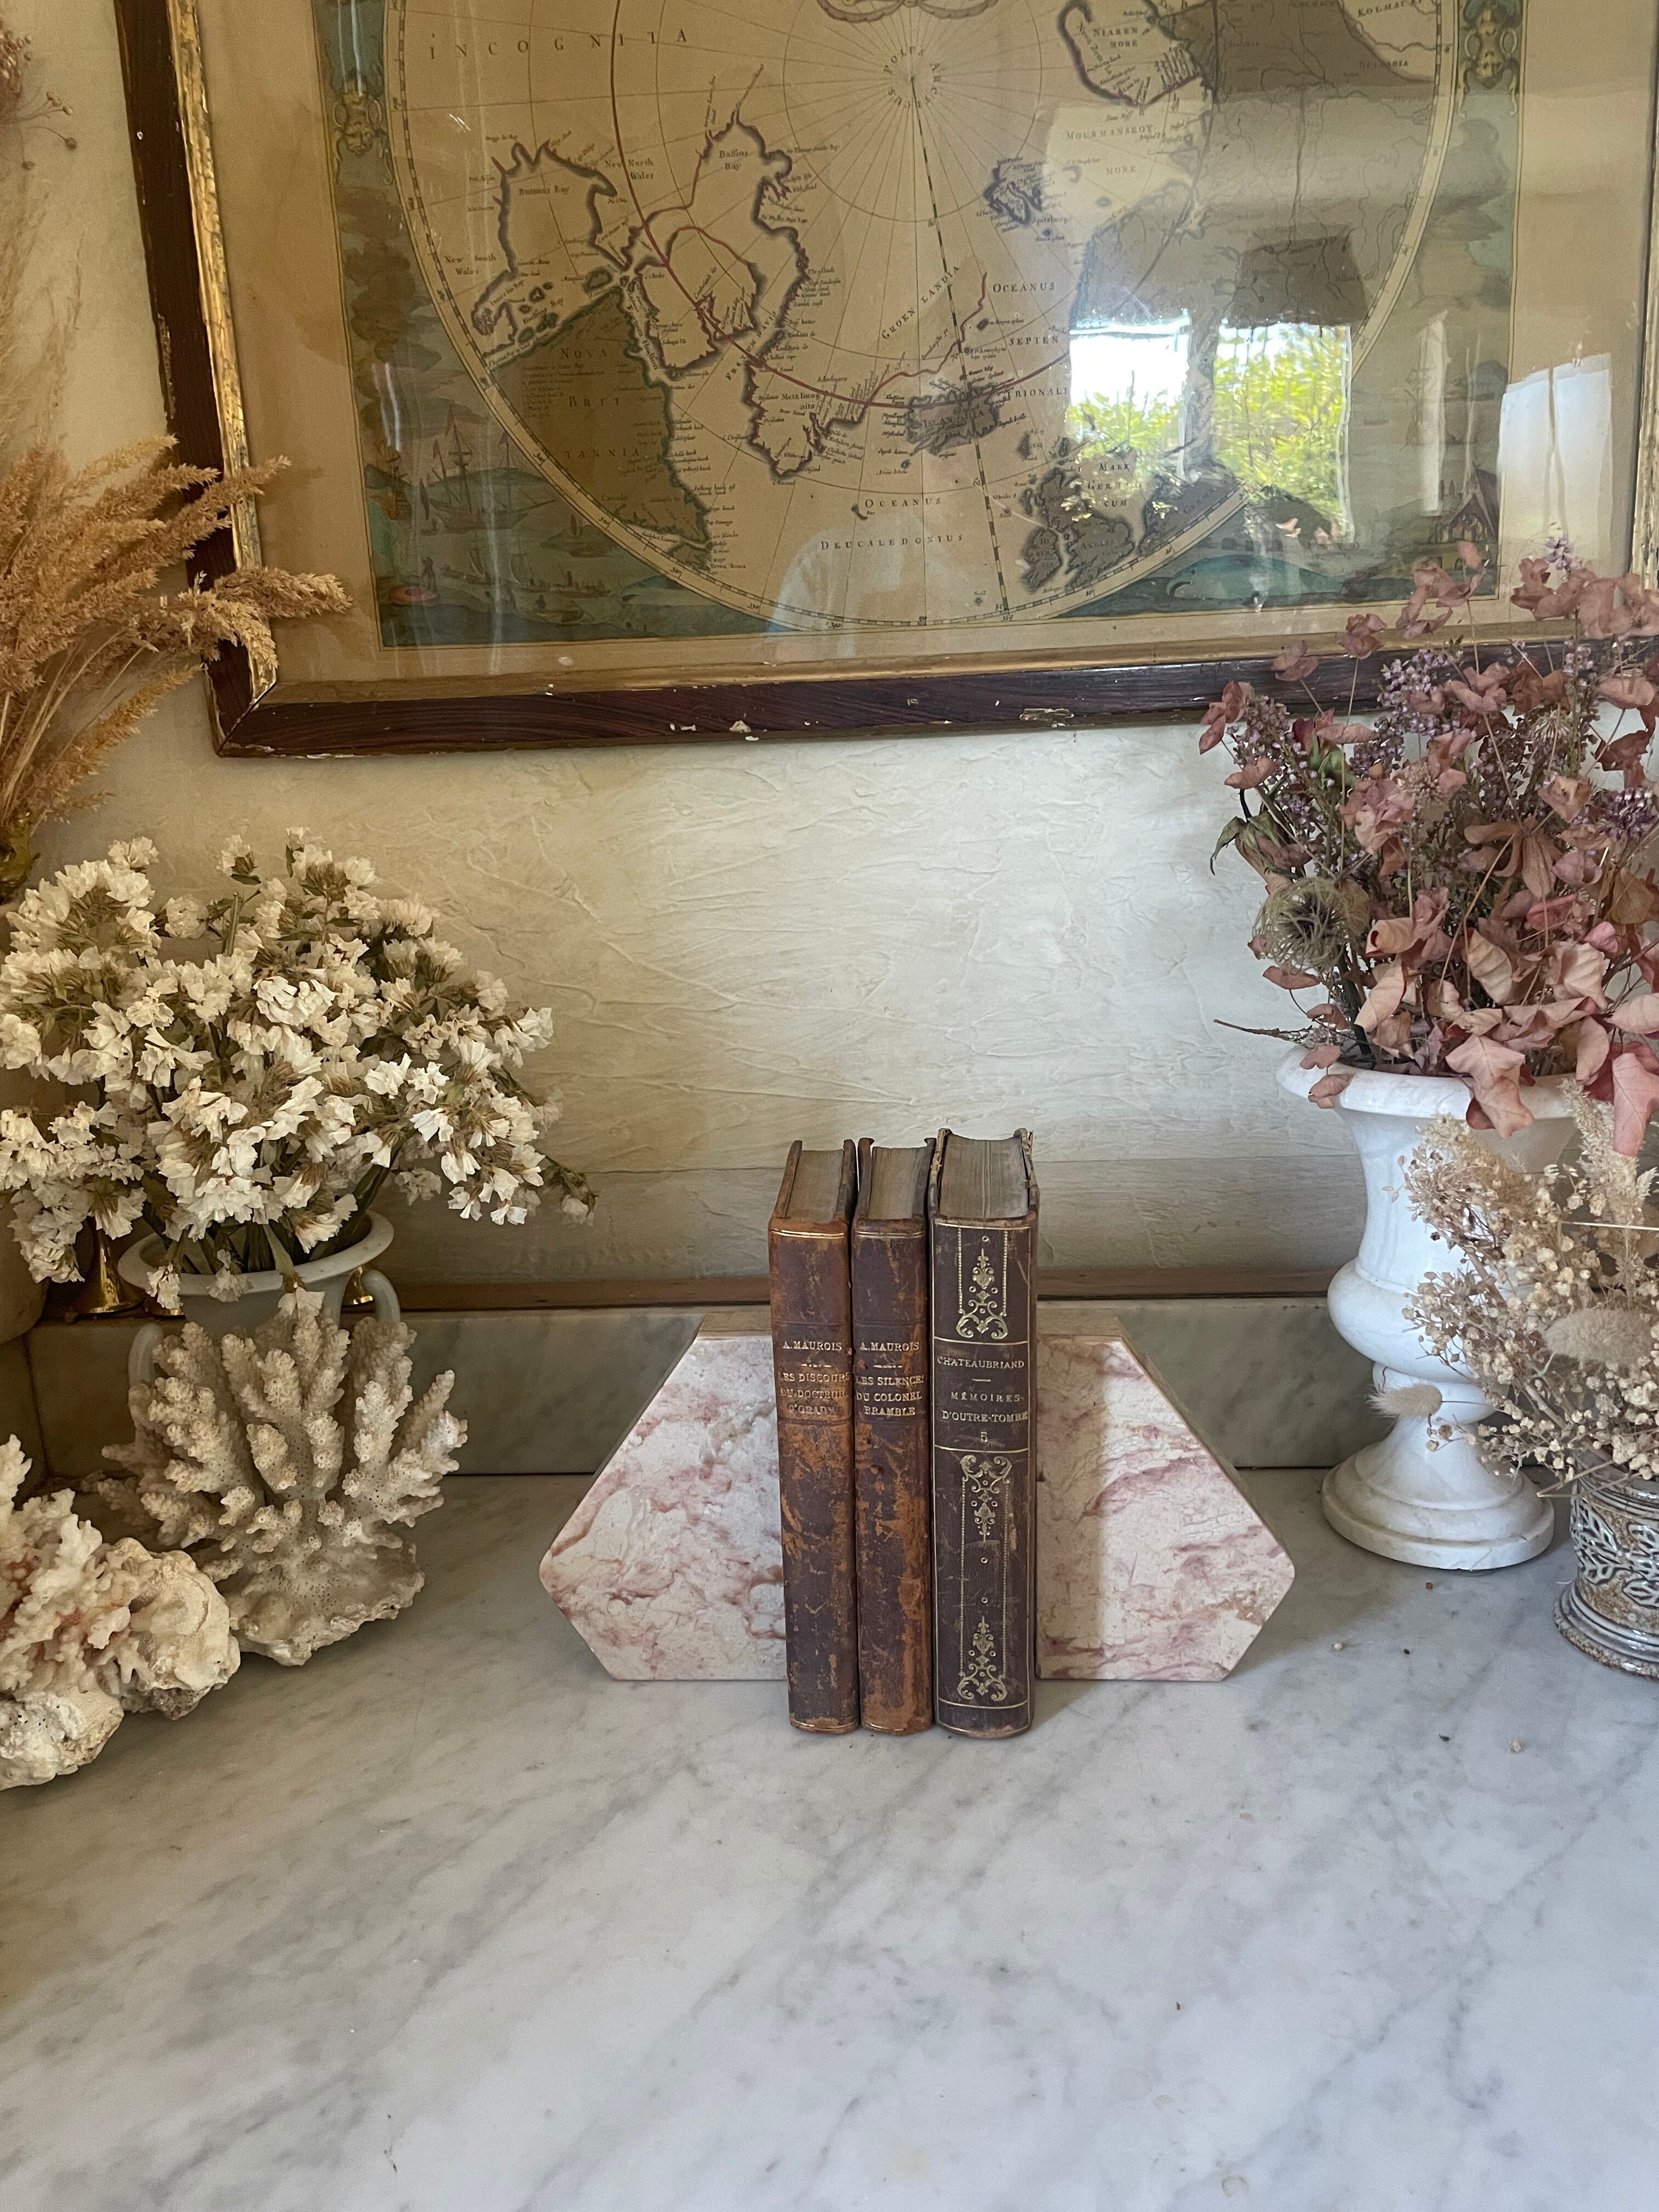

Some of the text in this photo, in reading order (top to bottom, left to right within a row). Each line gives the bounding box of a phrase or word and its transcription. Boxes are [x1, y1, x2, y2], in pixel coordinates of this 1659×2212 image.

[429, 29, 687, 59] INCOGNITA
[725, 162, 740, 171] Bay
[992, 281, 1055, 294] OCEANUS
[1009, 335, 1059, 347] SEPTEN
[560, 348, 608, 359] NOVA
[865, 496, 941, 510] OCEANUS
[783, 1341, 843, 1351] A.MAUROIS
[859, 1342, 919, 1352] A.MAUROIS
[937, 1356, 1025, 1369] CHATEAUBRIAND
[798, 1372, 850, 1383] DISCOURS
[856, 1375, 874, 1386] LES
[798, 1389, 846, 1400] DOCTEUR
[856, 1391, 922, 1402] DU COLONEL
[864, 1406, 916, 1417] BRAMBLE
[941, 1410, 1029, 1423] D'OUTRE-TOMBE
[980, 1431, 988, 1443] 5
